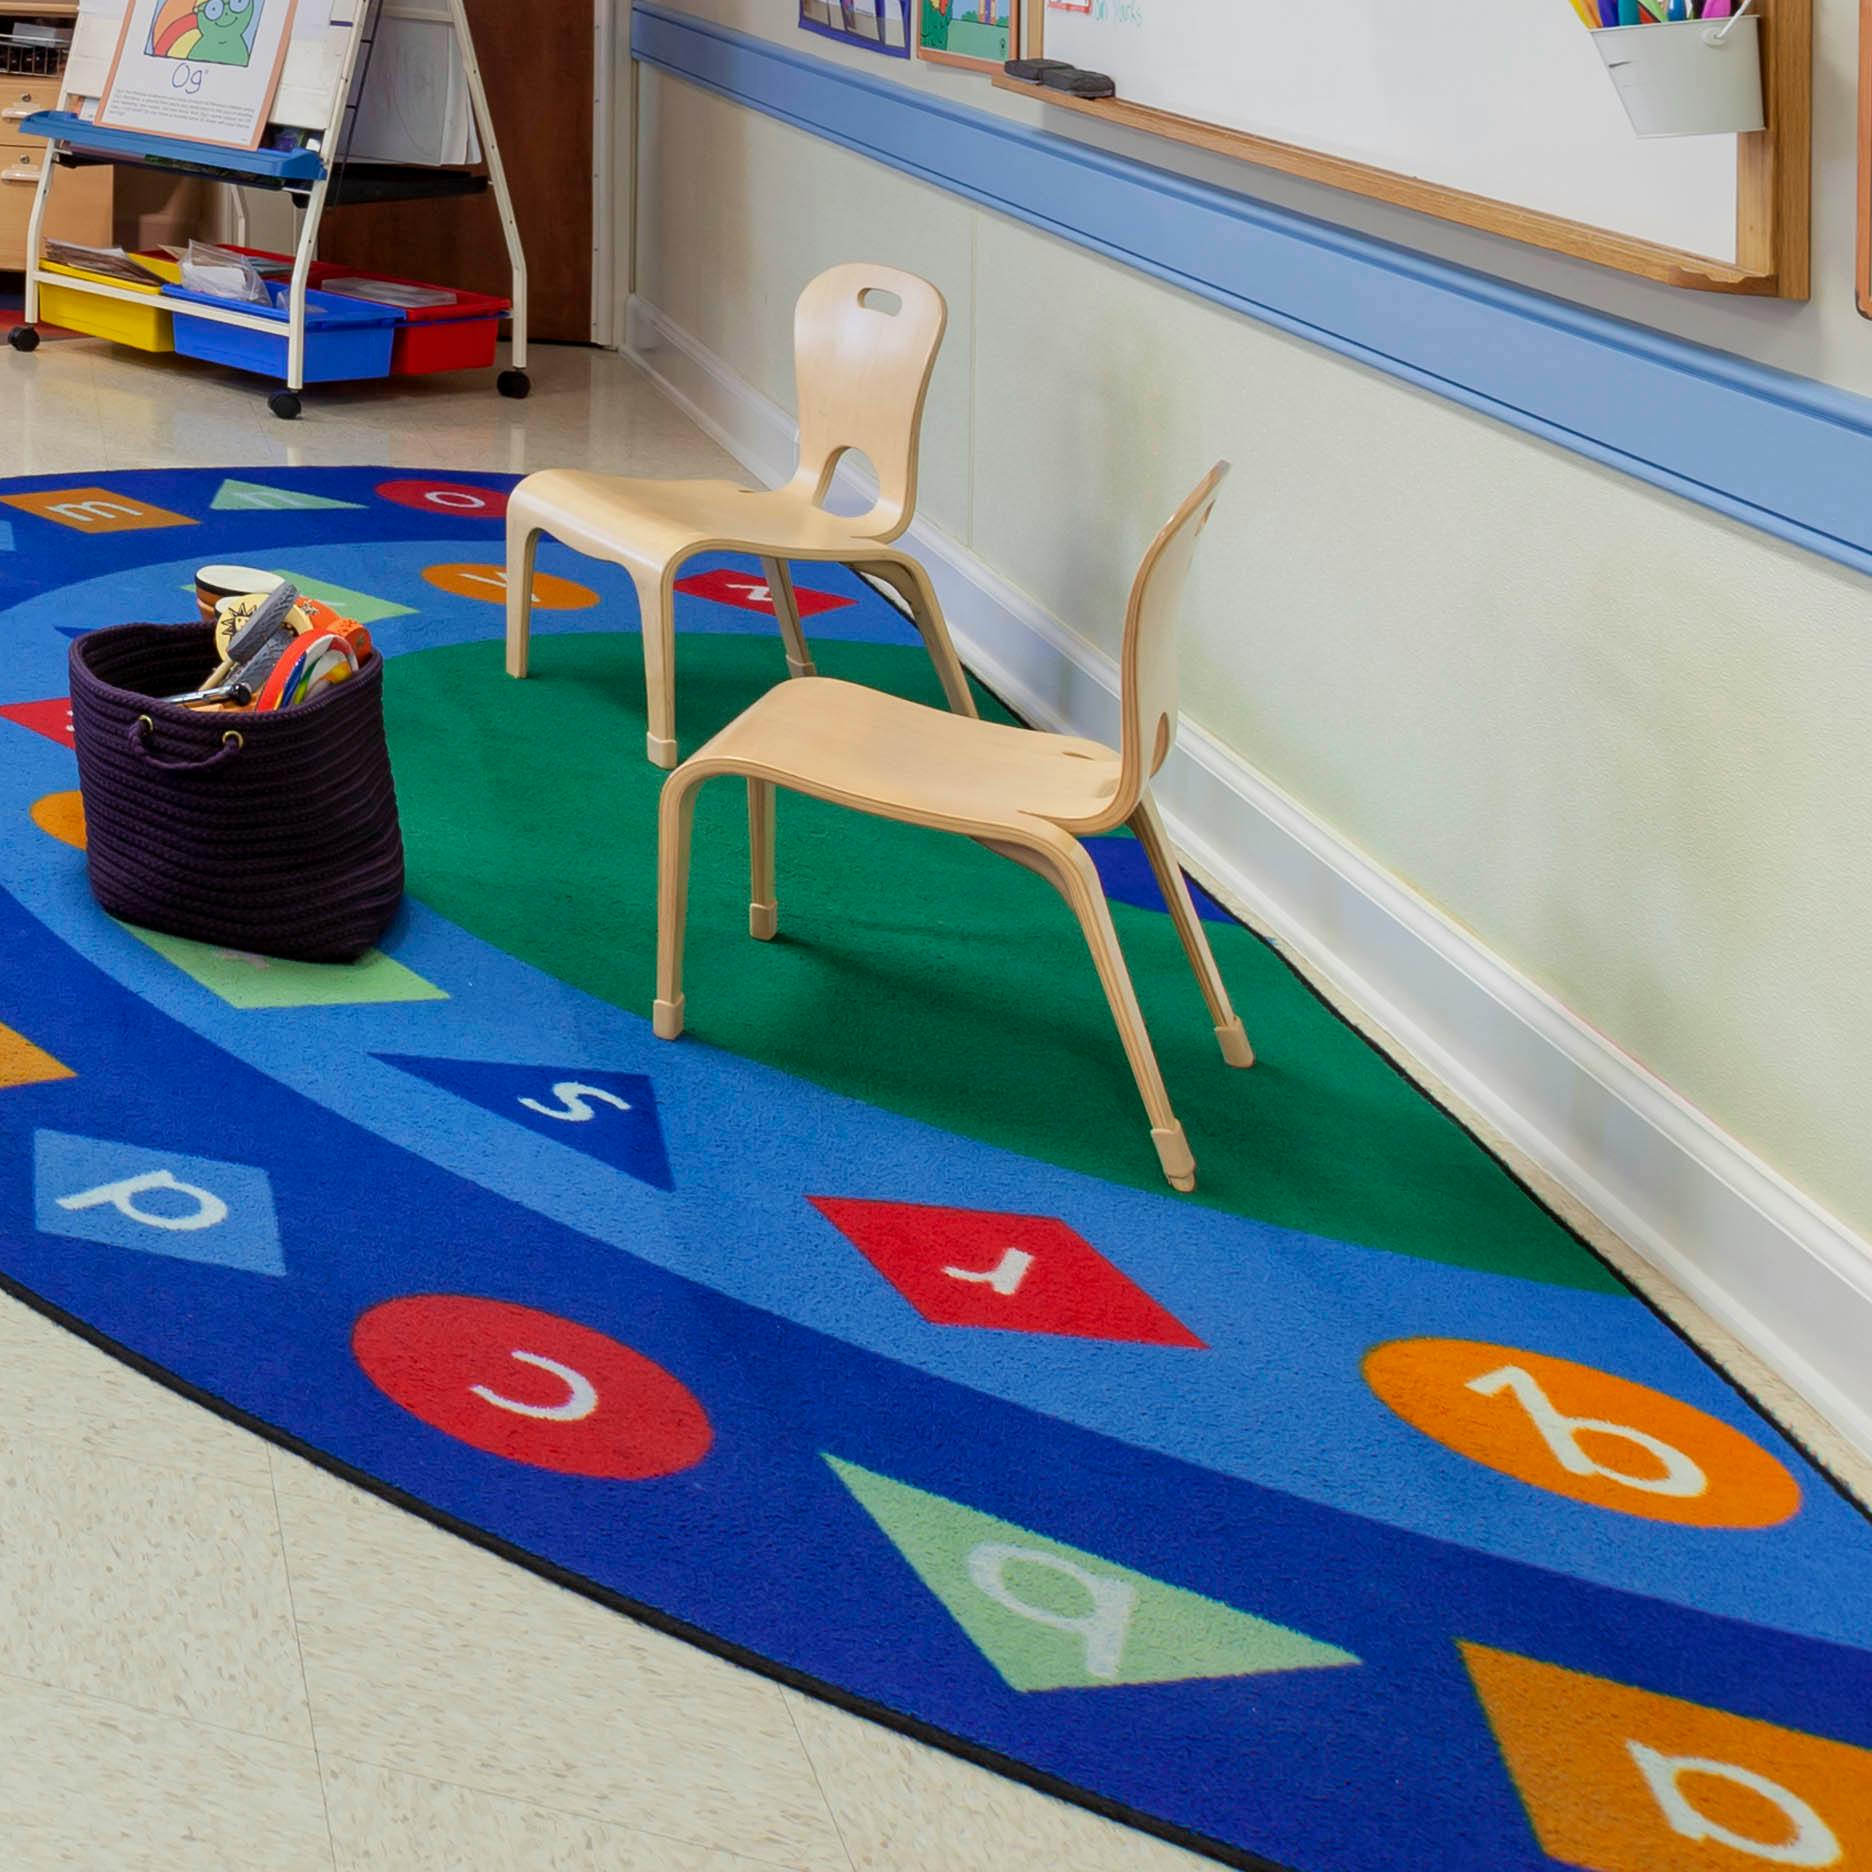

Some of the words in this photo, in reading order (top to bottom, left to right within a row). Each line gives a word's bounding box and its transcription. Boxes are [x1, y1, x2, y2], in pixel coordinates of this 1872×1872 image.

[44, 499, 144, 524] m
[515, 1078, 634, 1125] s
[468, 1348, 599, 1423] c
